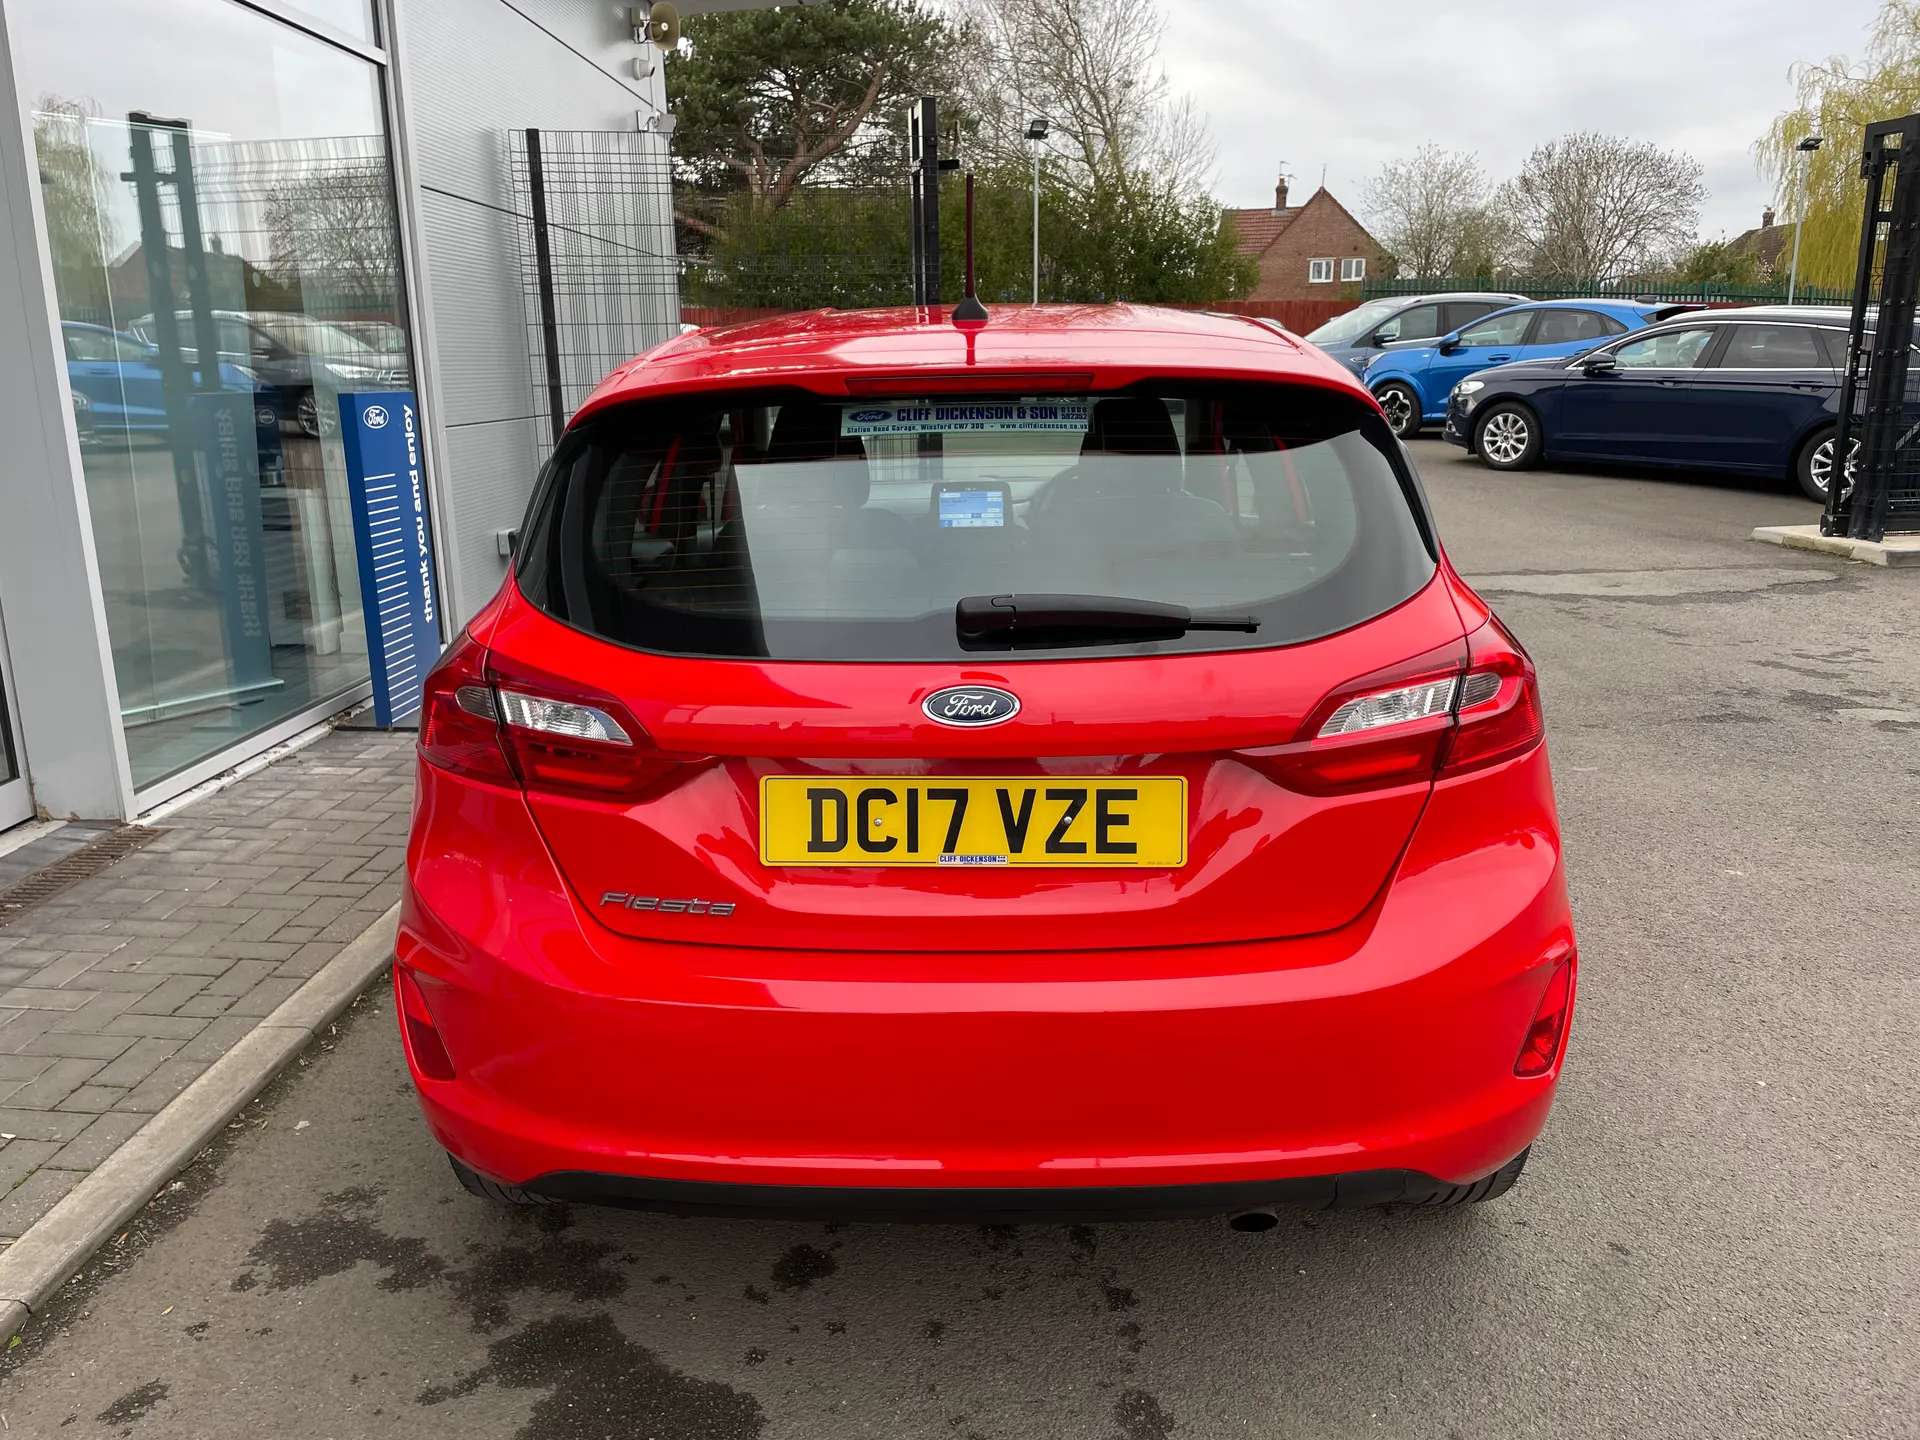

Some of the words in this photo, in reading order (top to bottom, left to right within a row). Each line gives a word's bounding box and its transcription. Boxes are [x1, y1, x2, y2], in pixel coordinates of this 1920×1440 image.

[367, 408, 386, 426] Ford
[847, 425, 871, 433] Station
[873, 424, 889, 432] Road
[896, 407, 931, 421] CLIFF
[935, 406, 1013, 420] DICKENSON
[1016, 406, 1027, 420] &
[1030, 406, 1058, 420] SON
[403, 404, 417, 466] enjoy
[409, 470, 422, 513] and
[415, 515, 428, 558] you
[420, 558, 433, 624] thank
[944, 694, 997, 716] Ford
[807, 788, 969, 853] DC17
[996, 788, 1138, 853] VZE
[600, 891, 736, 915] Fiesta
